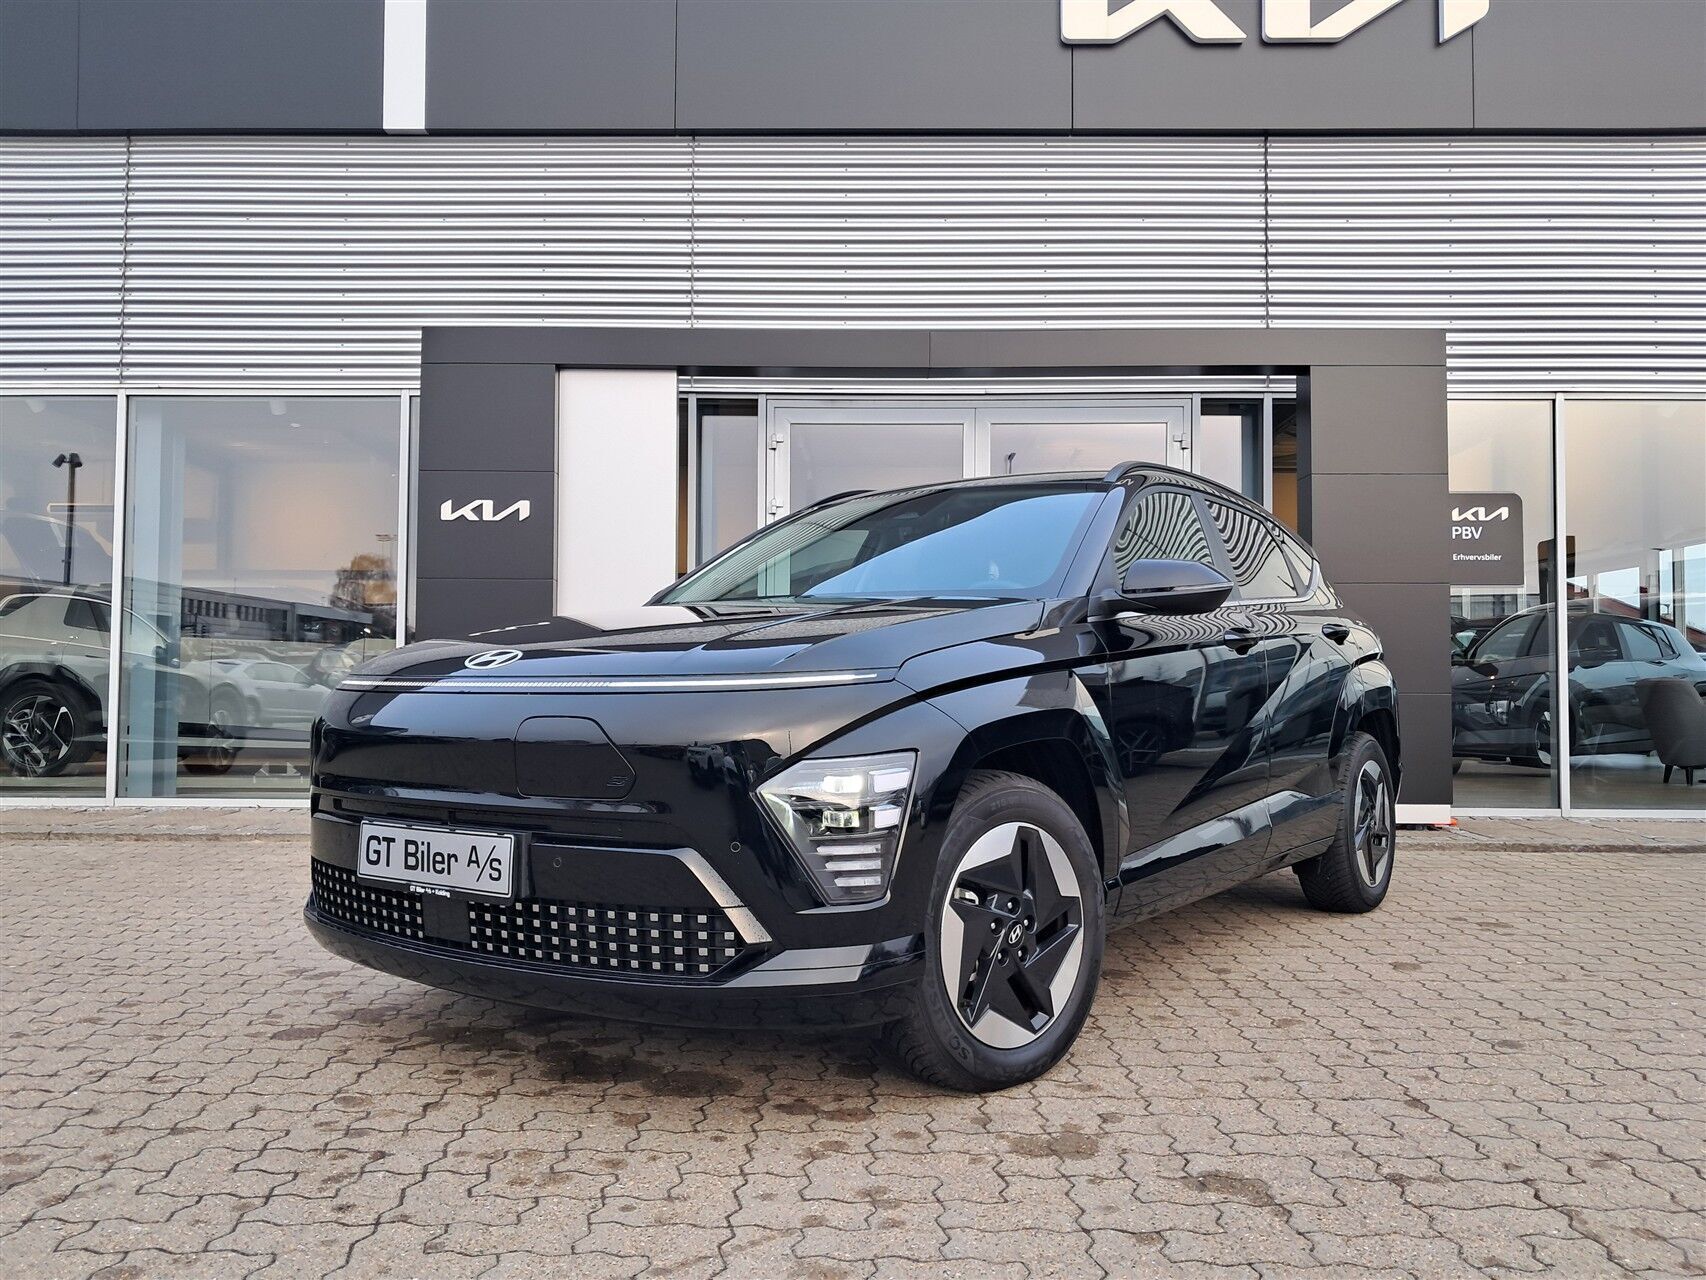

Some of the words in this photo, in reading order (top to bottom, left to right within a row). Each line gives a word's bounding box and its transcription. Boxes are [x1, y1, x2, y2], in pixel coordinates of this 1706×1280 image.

[440, 499, 530, 522] KIA
[1451, 506, 1509, 521] KIA
[1451, 526, 1483, 540] PBV
[1452, 553, 1502, 561] Erhvervsbiler
[365, 834, 396, 868] GT
[403, 838, 459, 876] Biler
